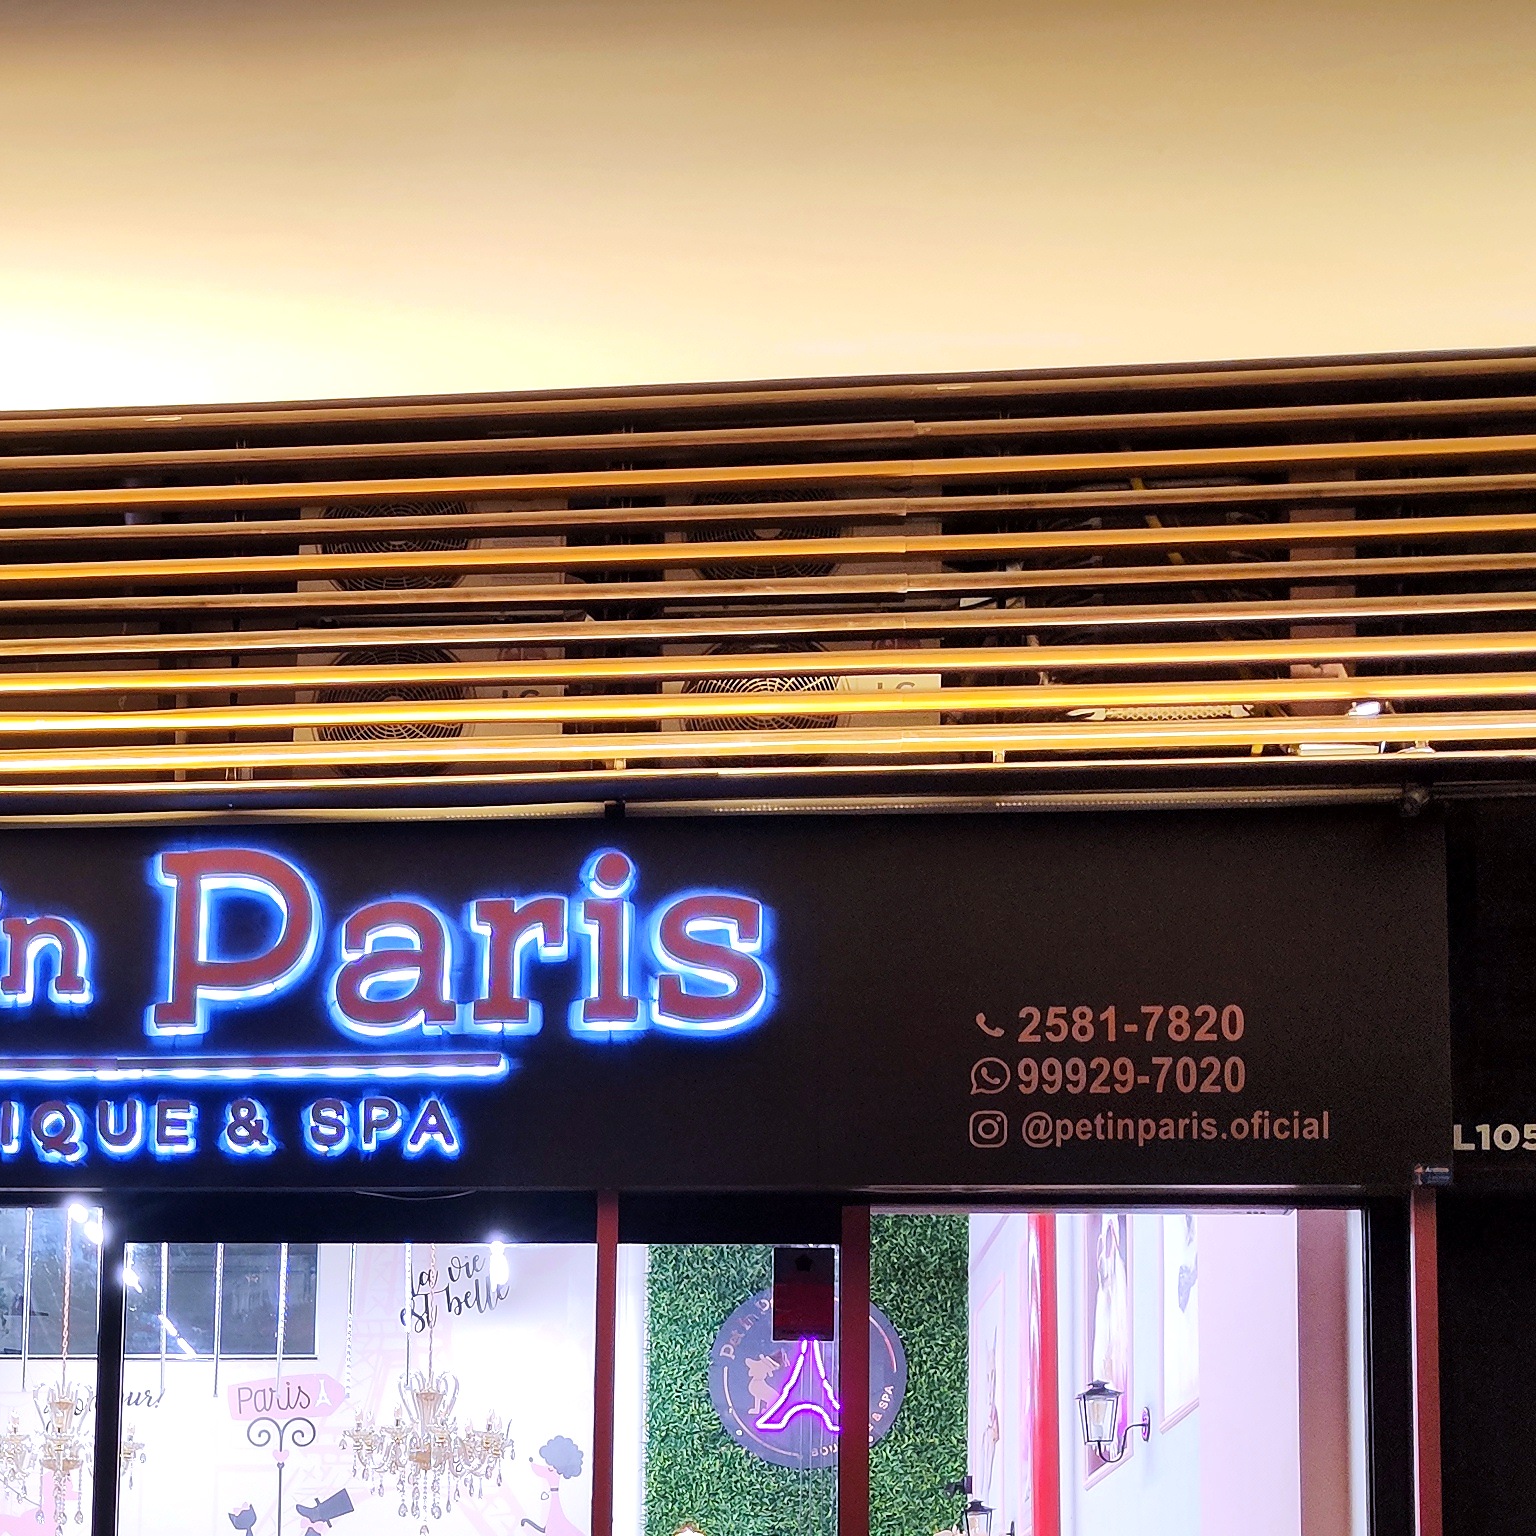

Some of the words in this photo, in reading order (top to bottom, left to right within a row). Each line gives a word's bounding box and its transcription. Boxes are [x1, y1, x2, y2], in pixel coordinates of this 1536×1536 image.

[149, 848, 768, 1036] Paris
[1017, 1003, 1246, 1042] 2581-7820
[1017, 1055, 1246, 1094] 99929-7020
[223, 1098, 272, 1155] &
[305, 1098, 460, 1156] SPA
[1021, 1110, 1330, 1148] @petinparis.oficial
[447, 1253, 486, 1283] vie
[236, 1381, 311, 1415] Paris
[878, 1384, 895, 1410] SPA
